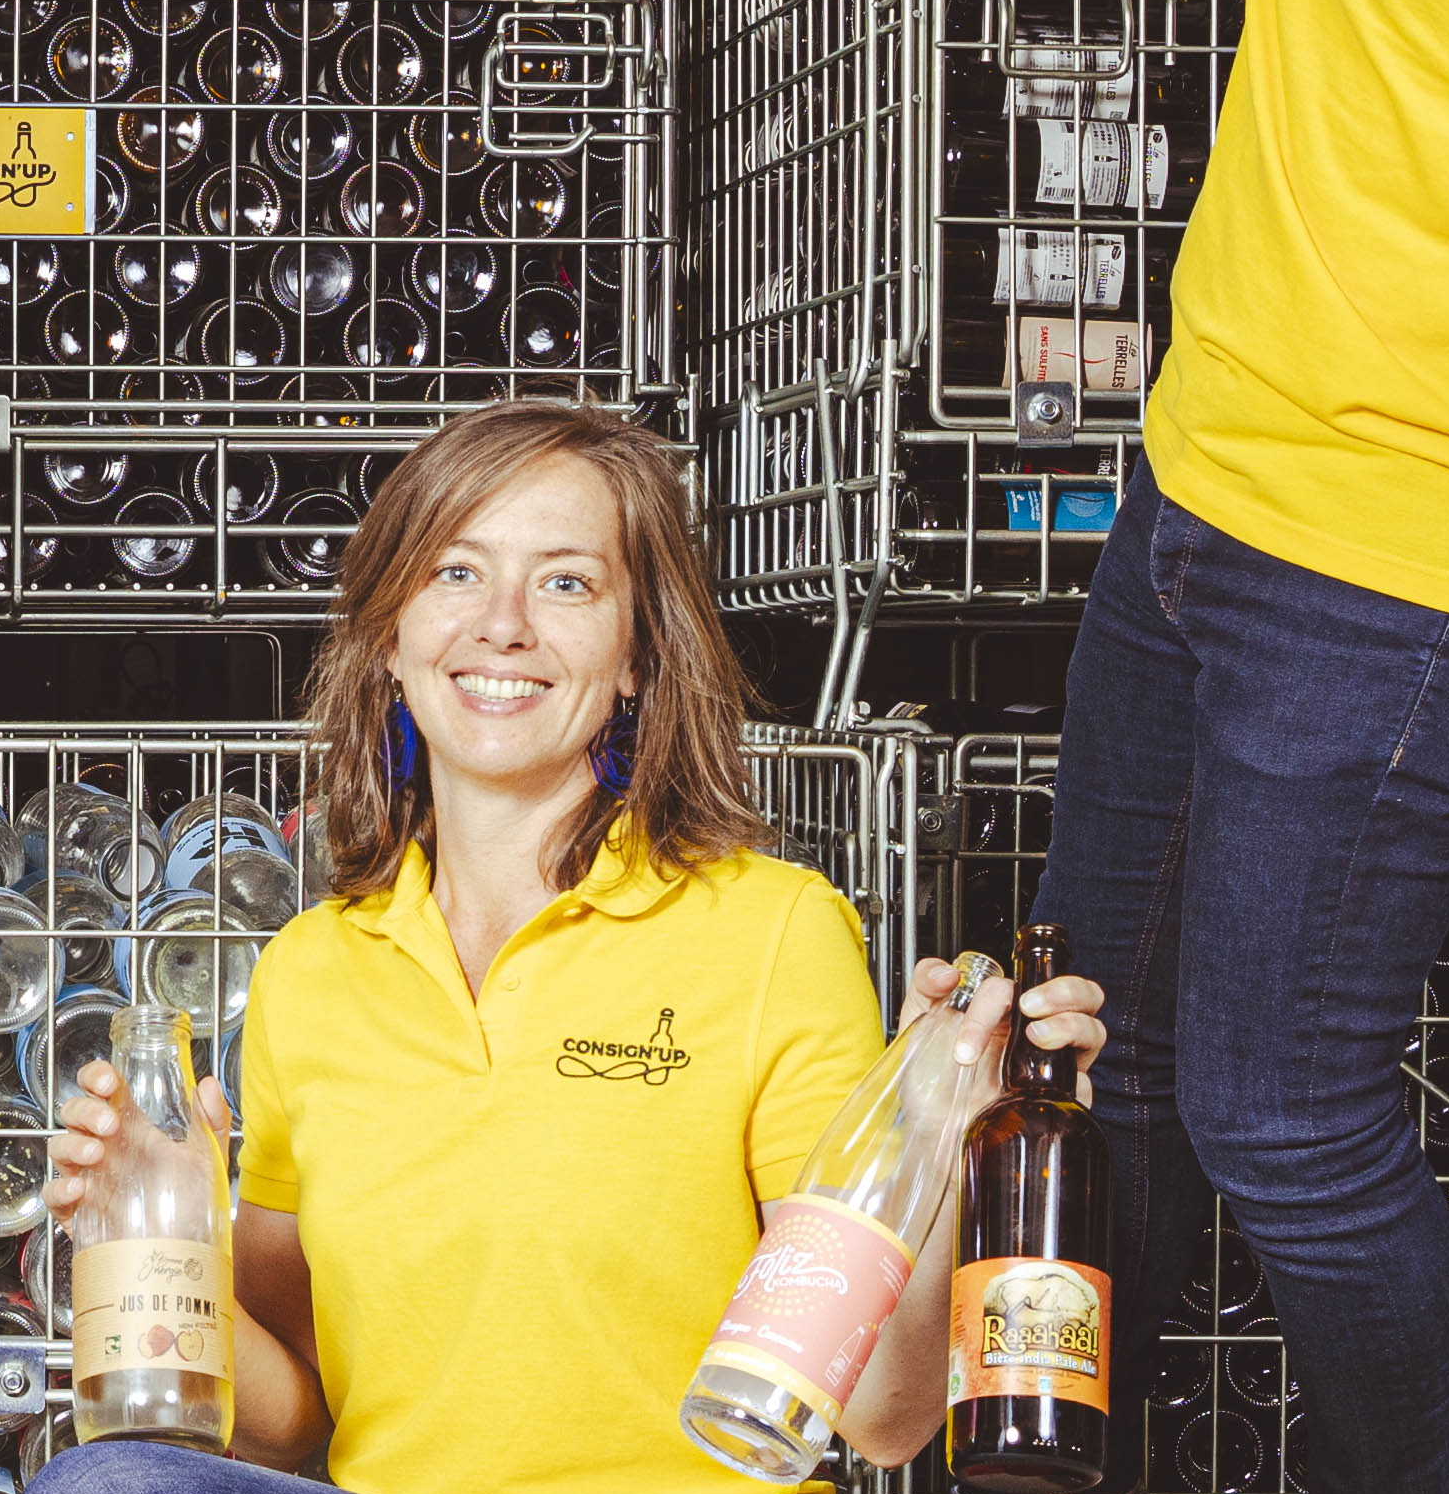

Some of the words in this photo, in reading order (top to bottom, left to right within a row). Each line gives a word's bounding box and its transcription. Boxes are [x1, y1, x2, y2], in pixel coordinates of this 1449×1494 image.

[1041, 325, 1049, 348] SANS
[1112, 335, 1128, 389] TERRELLES
[563, 1037, 687, 1063] CONSIGN'UP
[774, 1275, 842, 1289] KOMBUCHA
[120, 1294, 144, 1313] JUS
[152, 1294, 168, 1311] DE
[176, 1295, 217, 1319] POMME
[983, 1315, 1099, 1357] Raaahaa!
[986, 1352, 1015, 1364] Bière
[1055, 1355, 1078, 1369] Pale
[1081, 1358, 1097, 1375] Ale
